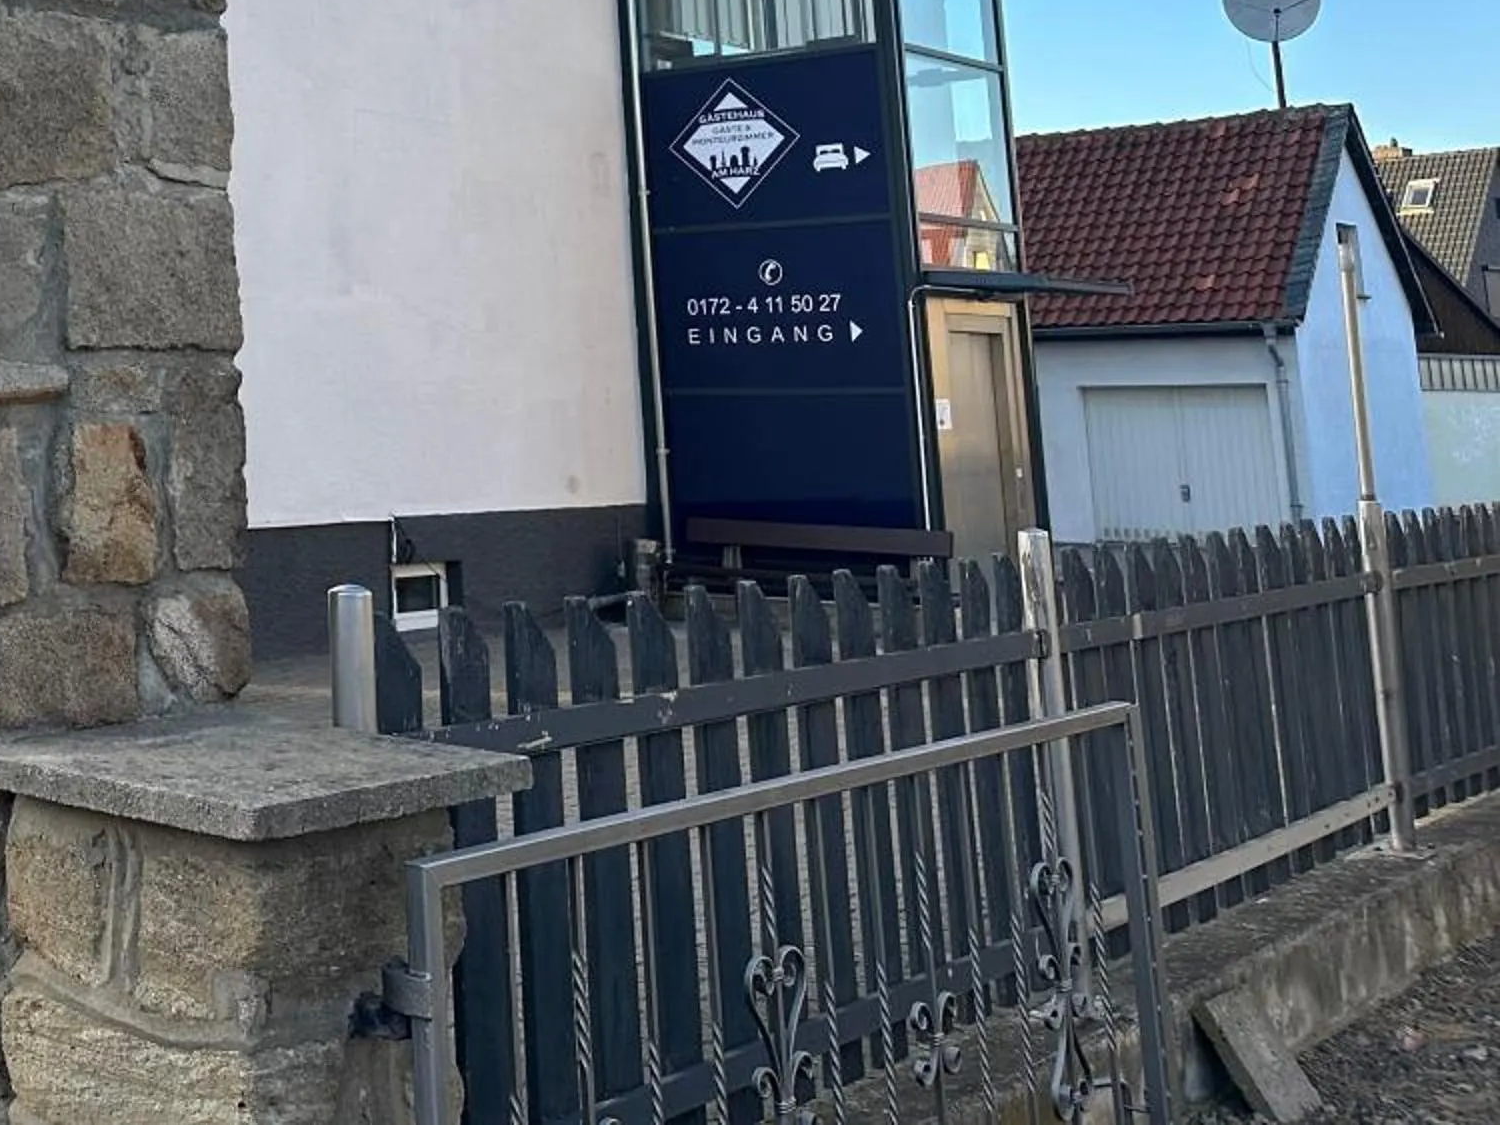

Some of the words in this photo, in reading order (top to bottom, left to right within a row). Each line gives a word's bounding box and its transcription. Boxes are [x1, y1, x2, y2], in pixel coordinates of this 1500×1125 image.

[711, 168, 728, 179] AM
[729, 165, 760, 176] HARZ
[687, 298, 731, 315] 0172
[747, 297, 758, 314] 4
[765, 295, 783, 313] 11
[791, 294, 813, 313] 50
[818, 293, 841, 312] 27
[688, 324, 833, 344] EINGANG
